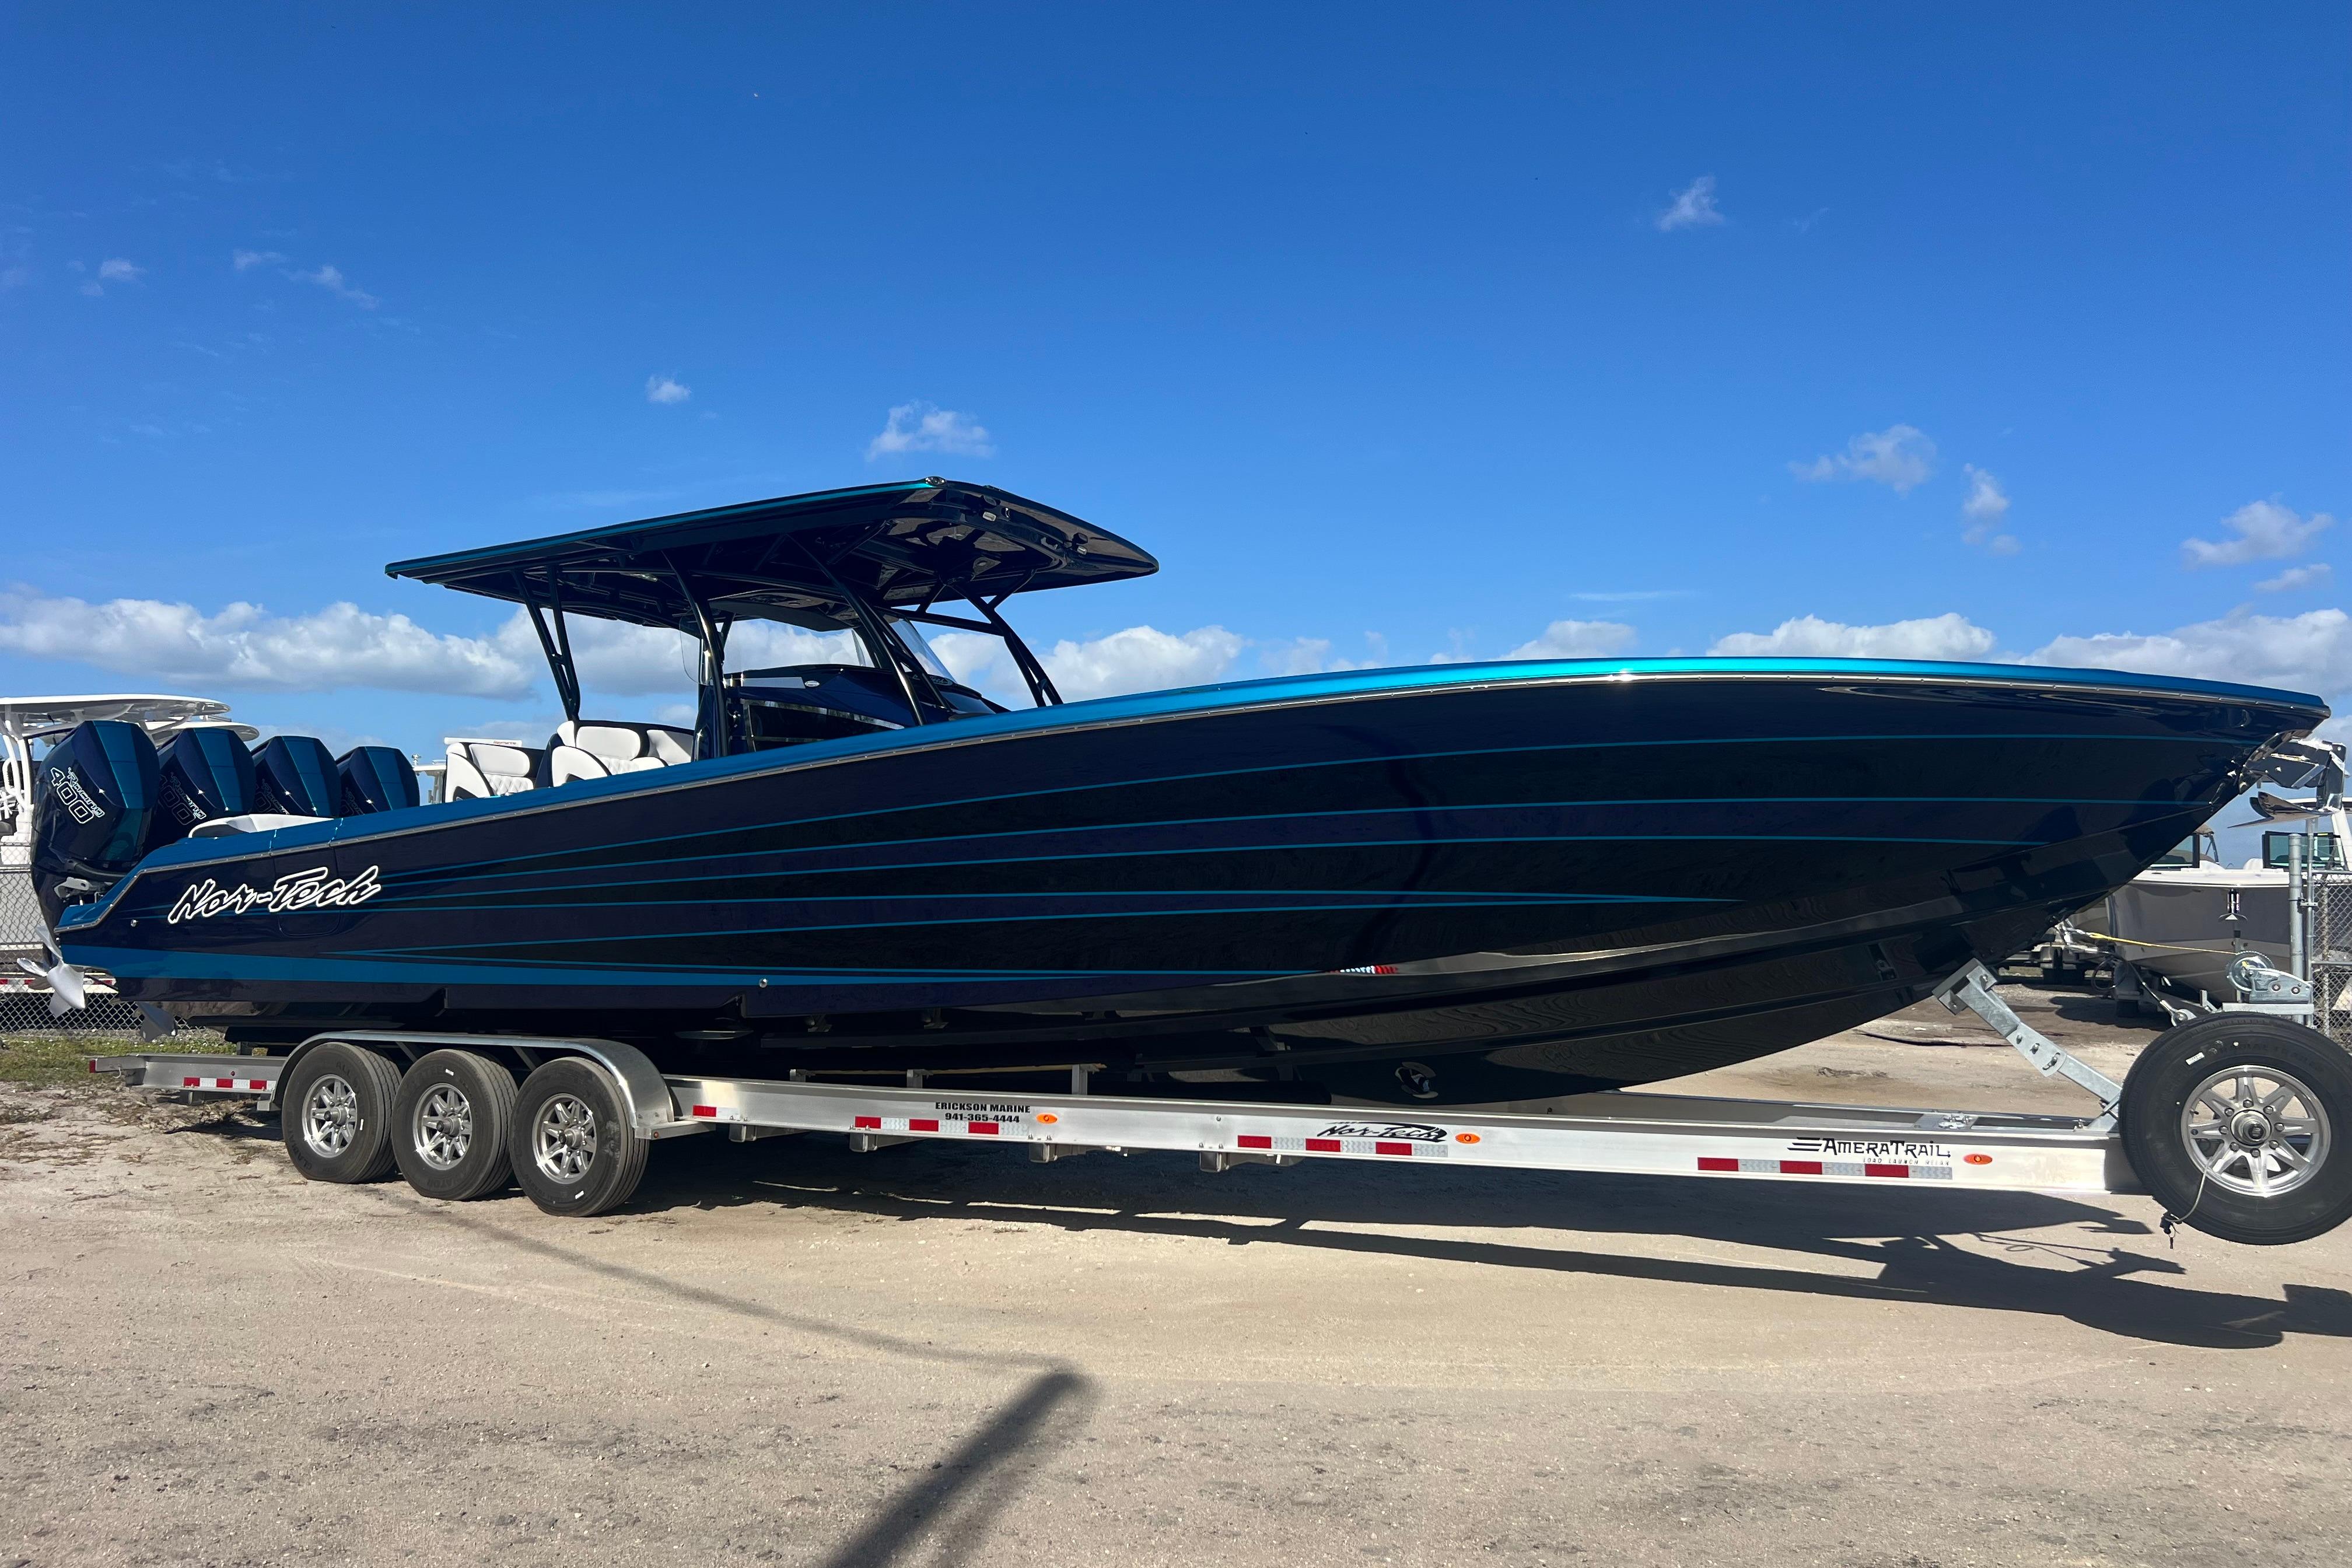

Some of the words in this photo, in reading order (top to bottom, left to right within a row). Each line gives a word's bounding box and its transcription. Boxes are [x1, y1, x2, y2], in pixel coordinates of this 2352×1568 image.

[50, 767, 94, 824] 400
[67, 766, 105, 818] Racing
[170, 772, 206, 820] Racing
[168, 865, 382, 924] Nor-Tech
[935, 1102, 987, 1112] ERICKSON
[990, 1104, 1031, 1113] MARINE
[945, 1112, 1020, 1123] 941-365-4444
[1317, 1124, 1443, 1140] Nor-Tech
